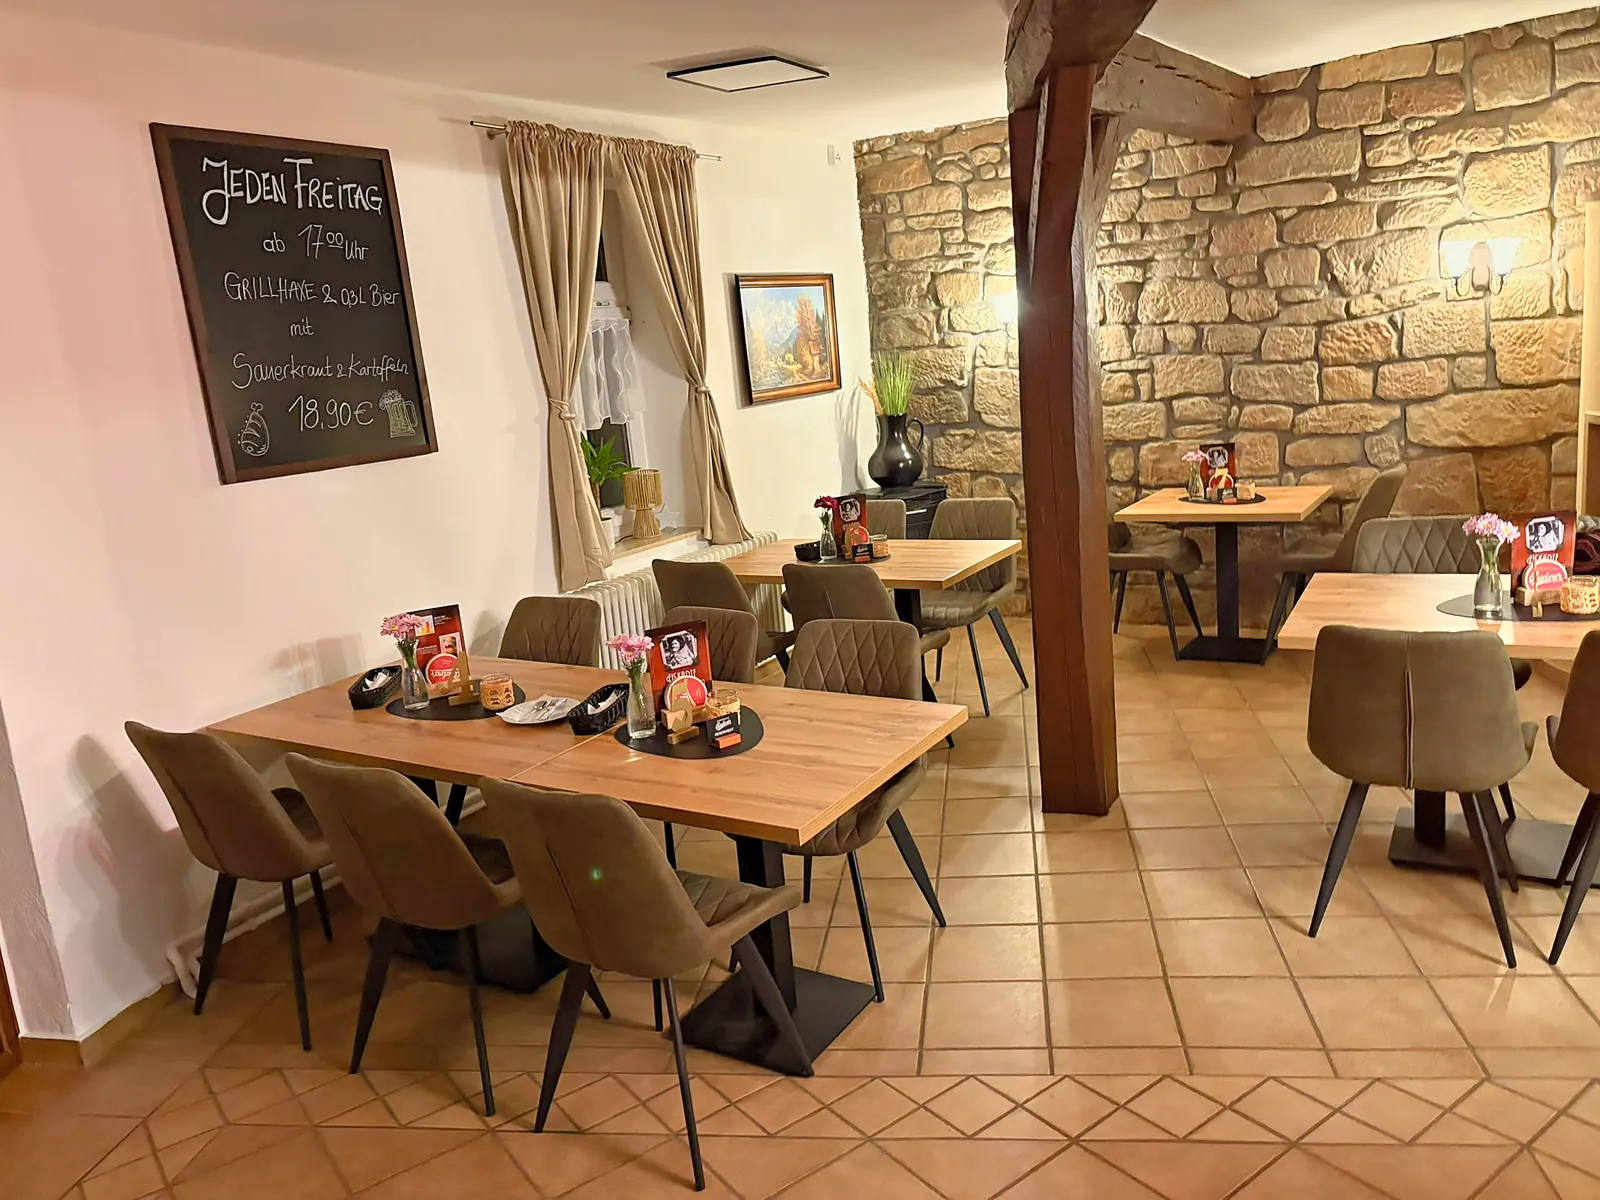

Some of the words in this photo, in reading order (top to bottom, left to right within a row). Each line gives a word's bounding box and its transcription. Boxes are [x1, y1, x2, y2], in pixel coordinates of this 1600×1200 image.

[201, 156, 288, 226] JEDEN
[262, 231, 286, 253] ab
[345, 239, 370, 261] Uhr
[224, 271, 318, 304] GRILLHAXE
[321, 284, 338, 305] &
[369, 283, 400, 307] Bier
[289, 316, 315, 337] mit
[231, 352, 334, 389] Sauerkraut
[336, 364, 347, 378] &
[347, 352, 410, 383] Kartoffeln
